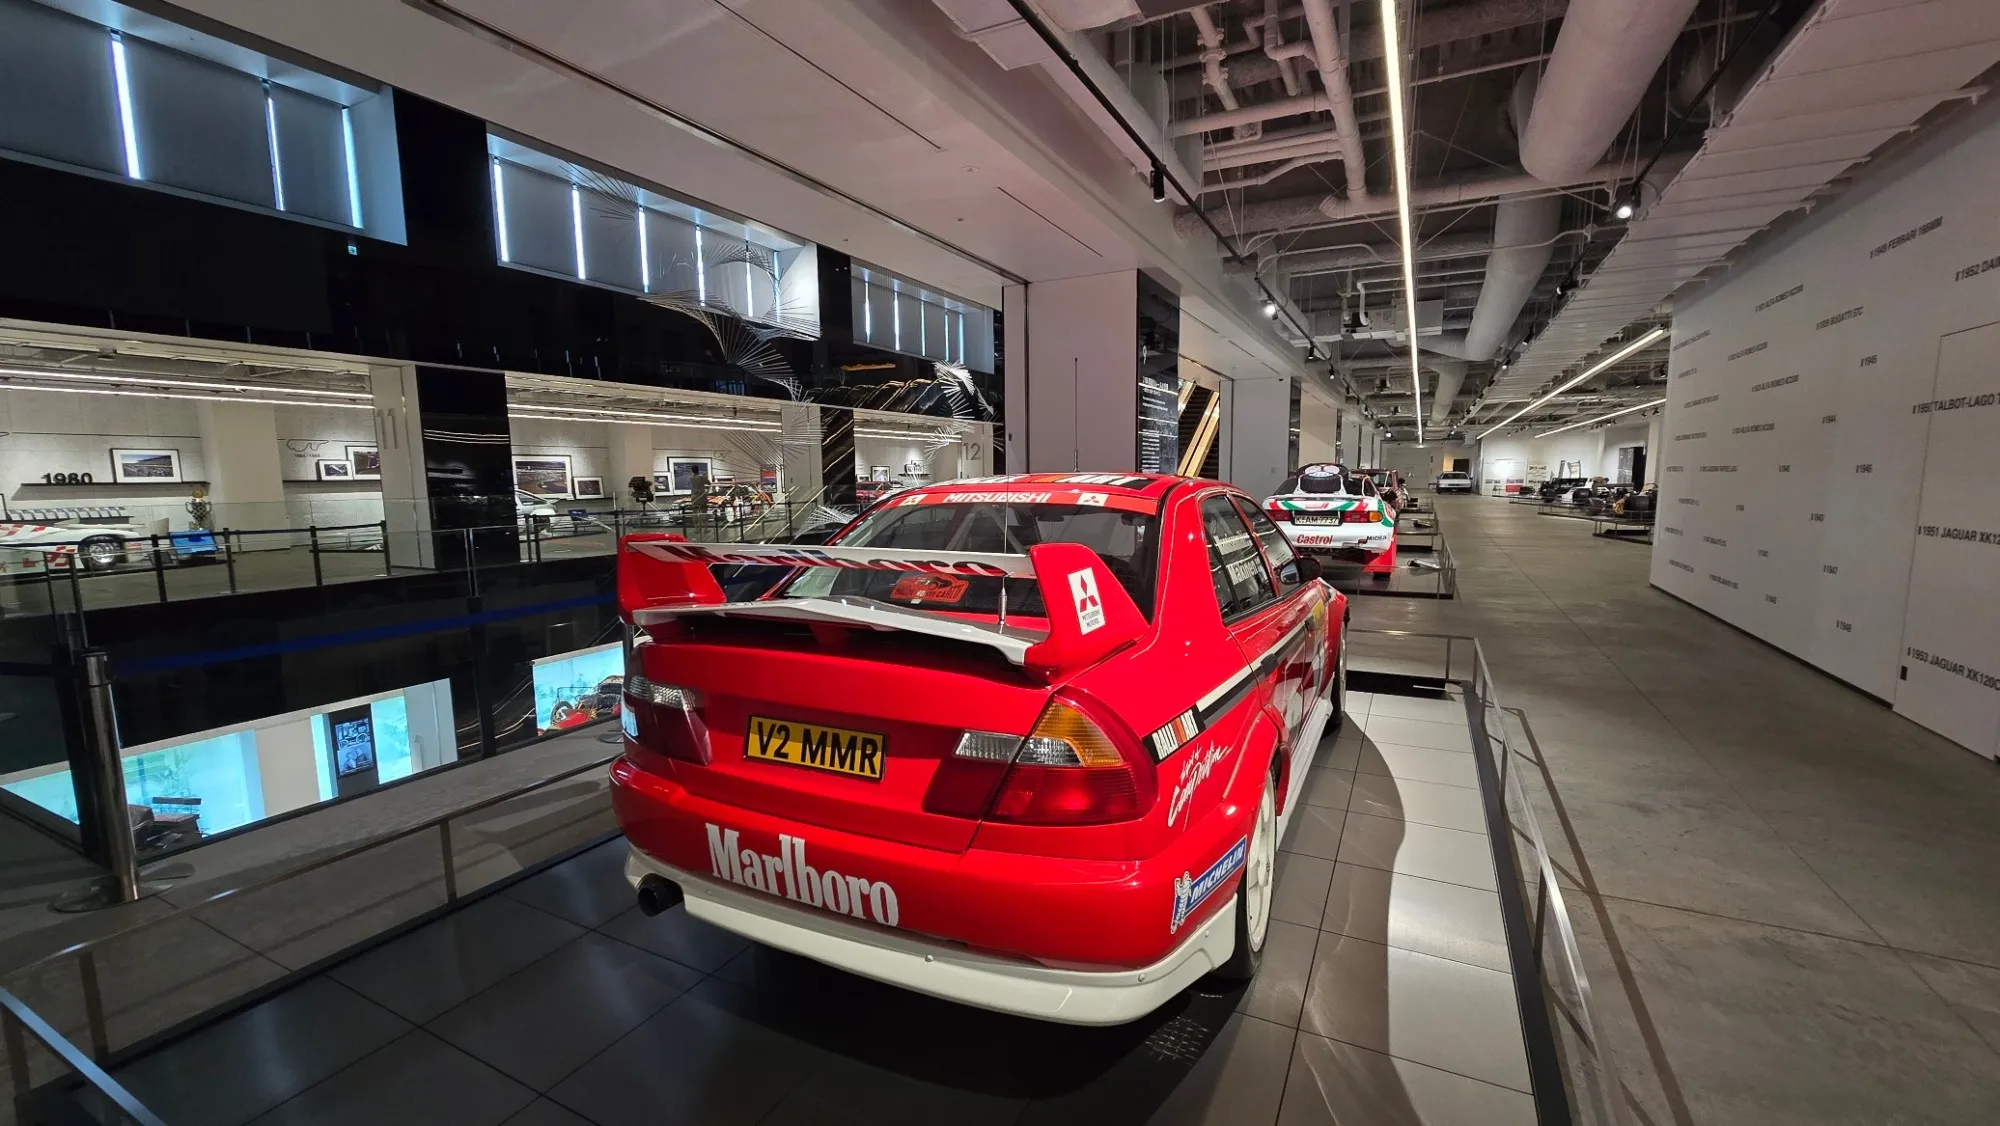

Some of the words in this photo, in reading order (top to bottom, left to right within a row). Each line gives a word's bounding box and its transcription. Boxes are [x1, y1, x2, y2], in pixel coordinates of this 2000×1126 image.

[1932, 393, 1995, 412] TALBOT-LAGO
[962, 442, 981, 461] 12
[41, 472, 94, 486] 1980
[942, 492, 1052, 504] MITSUBISHI
[1296, 534, 1333, 545] Castrol
[1923, 525, 1940, 537] 1951
[1941, 527, 1977, 542] JAGUAR
[1929, 654, 1965, 677] JAGUAR
[756, 721, 791, 760] V2
[800, 727, 879, 776] MMR
[704, 822, 900, 928] Marlboro
[1190, 842, 1246, 904] MICHELIN
